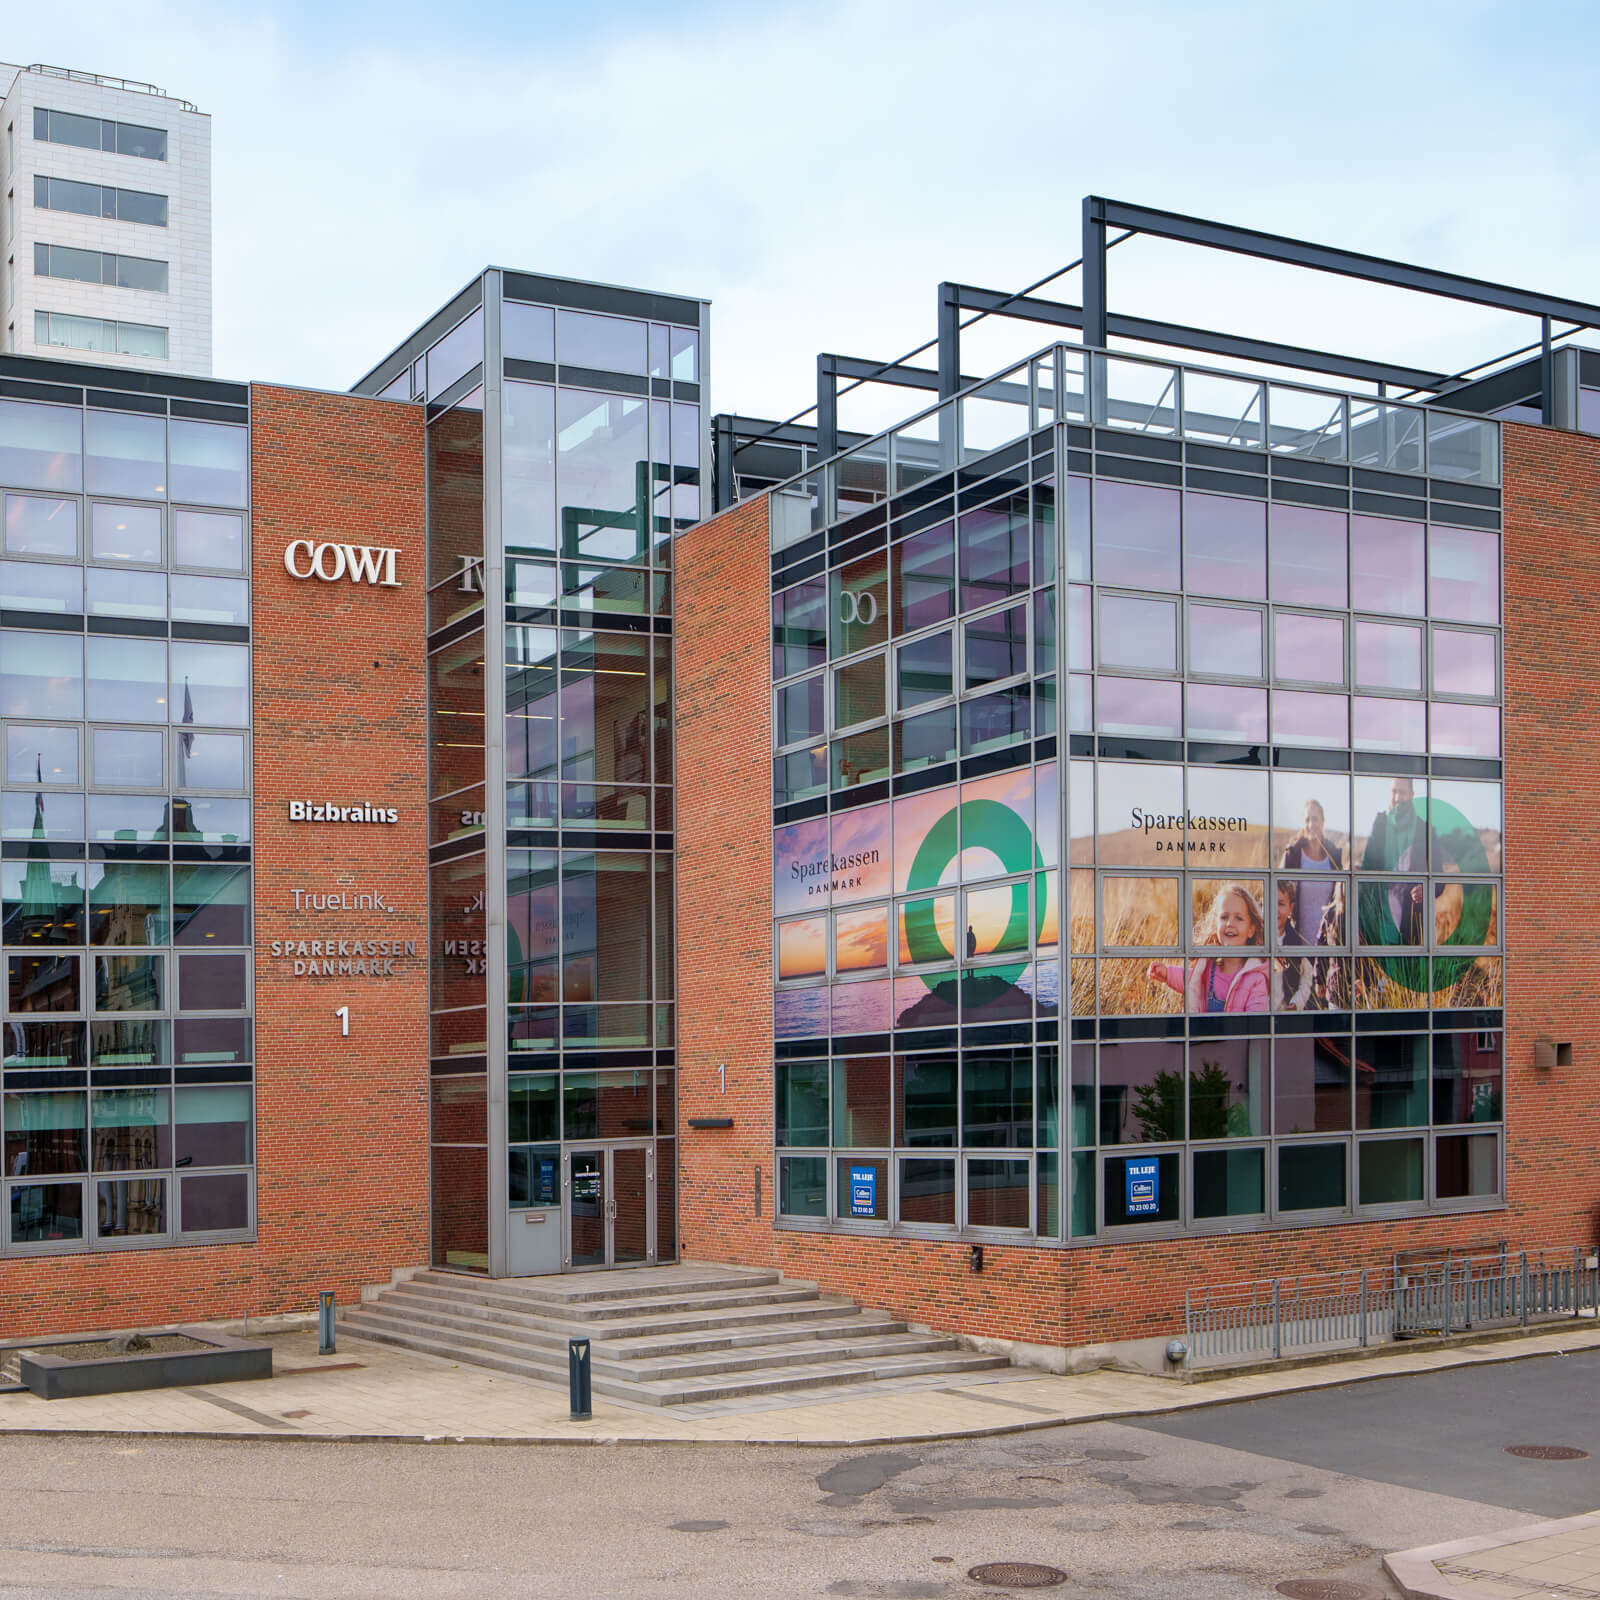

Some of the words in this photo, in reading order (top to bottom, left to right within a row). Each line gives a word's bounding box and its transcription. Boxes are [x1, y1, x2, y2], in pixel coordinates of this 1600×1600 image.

[284, 540, 402, 586] COWI
[289, 800, 398, 823] Bizbrains
[1131, 807, 1247, 835] Sparekassen
[1156, 841, 1226, 852] DANMARK
[791, 849, 879, 883] Sparekassen
[808, 877, 862, 895] DANMARK
[271, 940, 416, 957] SPAREKASSEN
[294, 960, 394, 976] DANMARK
[336, 1006, 349, 1037] 1
[718, 1063, 726, 1095] 1
